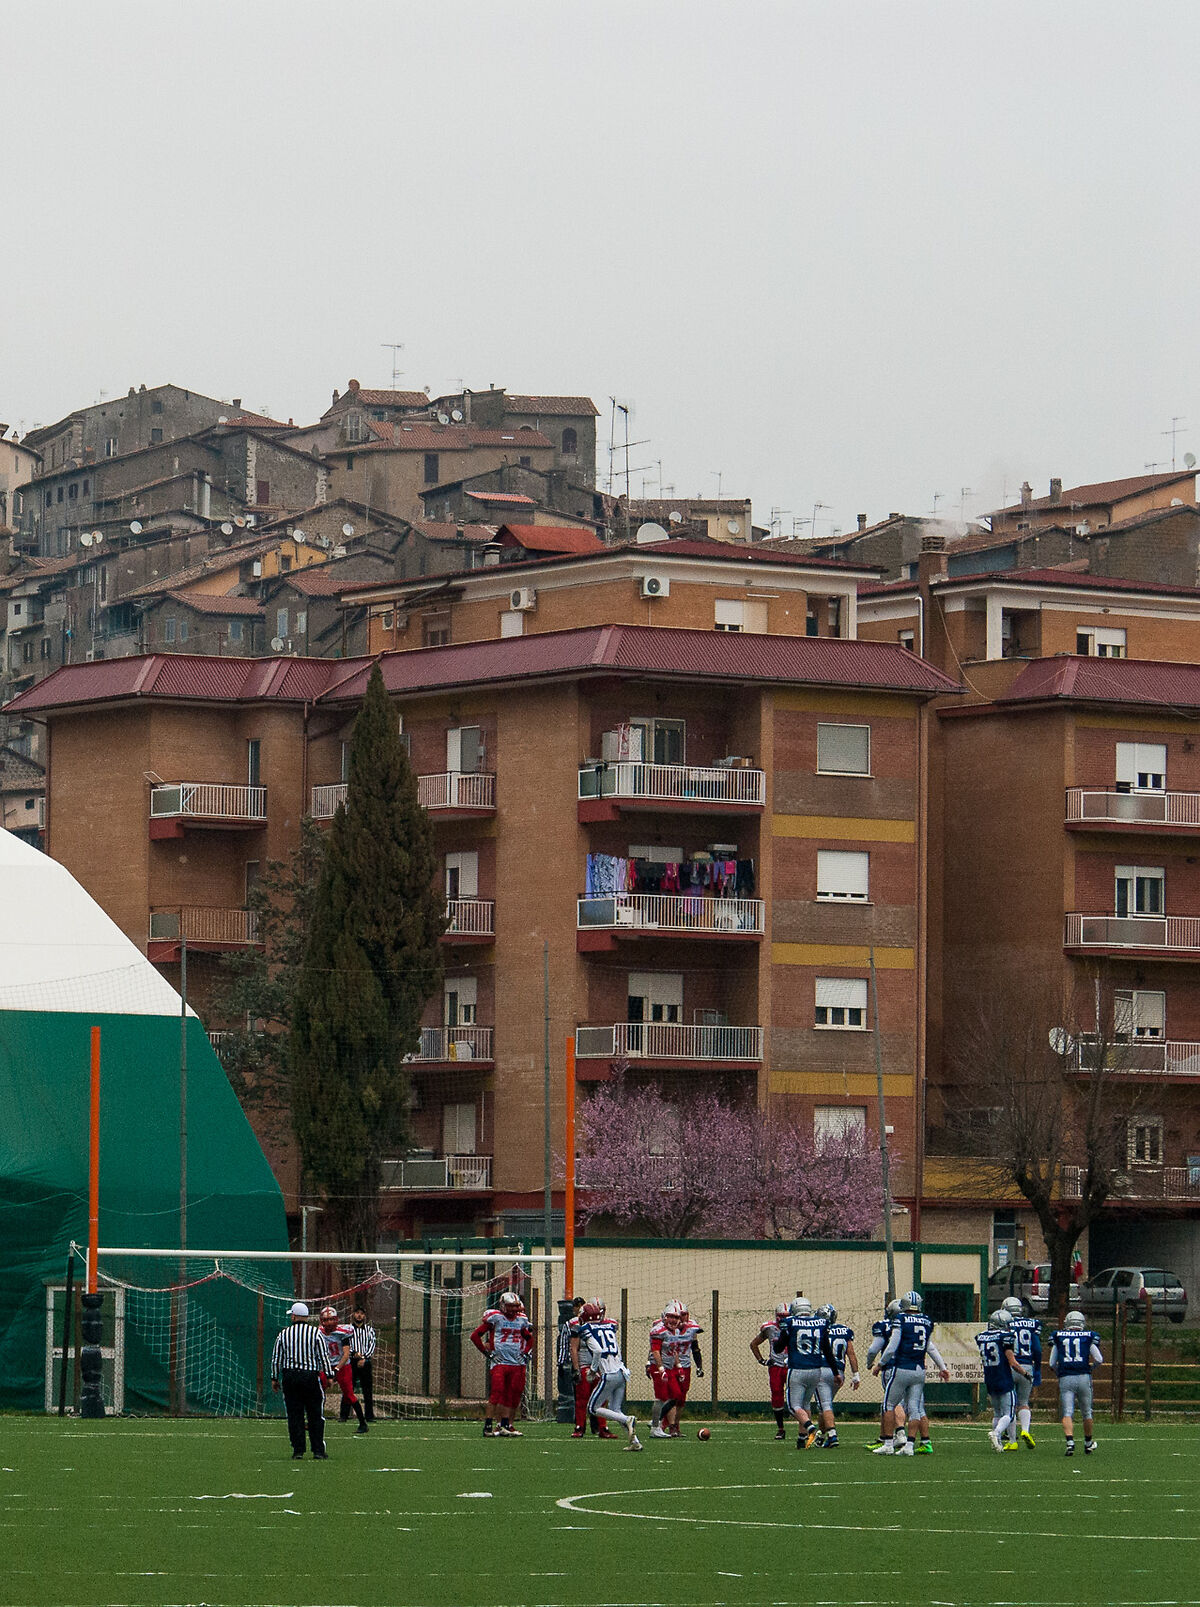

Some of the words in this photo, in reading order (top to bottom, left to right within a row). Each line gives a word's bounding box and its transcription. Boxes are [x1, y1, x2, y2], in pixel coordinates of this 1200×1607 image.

[597, 1329, 619, 1354] 19
[796, 1328, 821, 1355] 61
[913, 1325, 927, 1351] 3
[1062, 1338, 1084, 1363] 11
